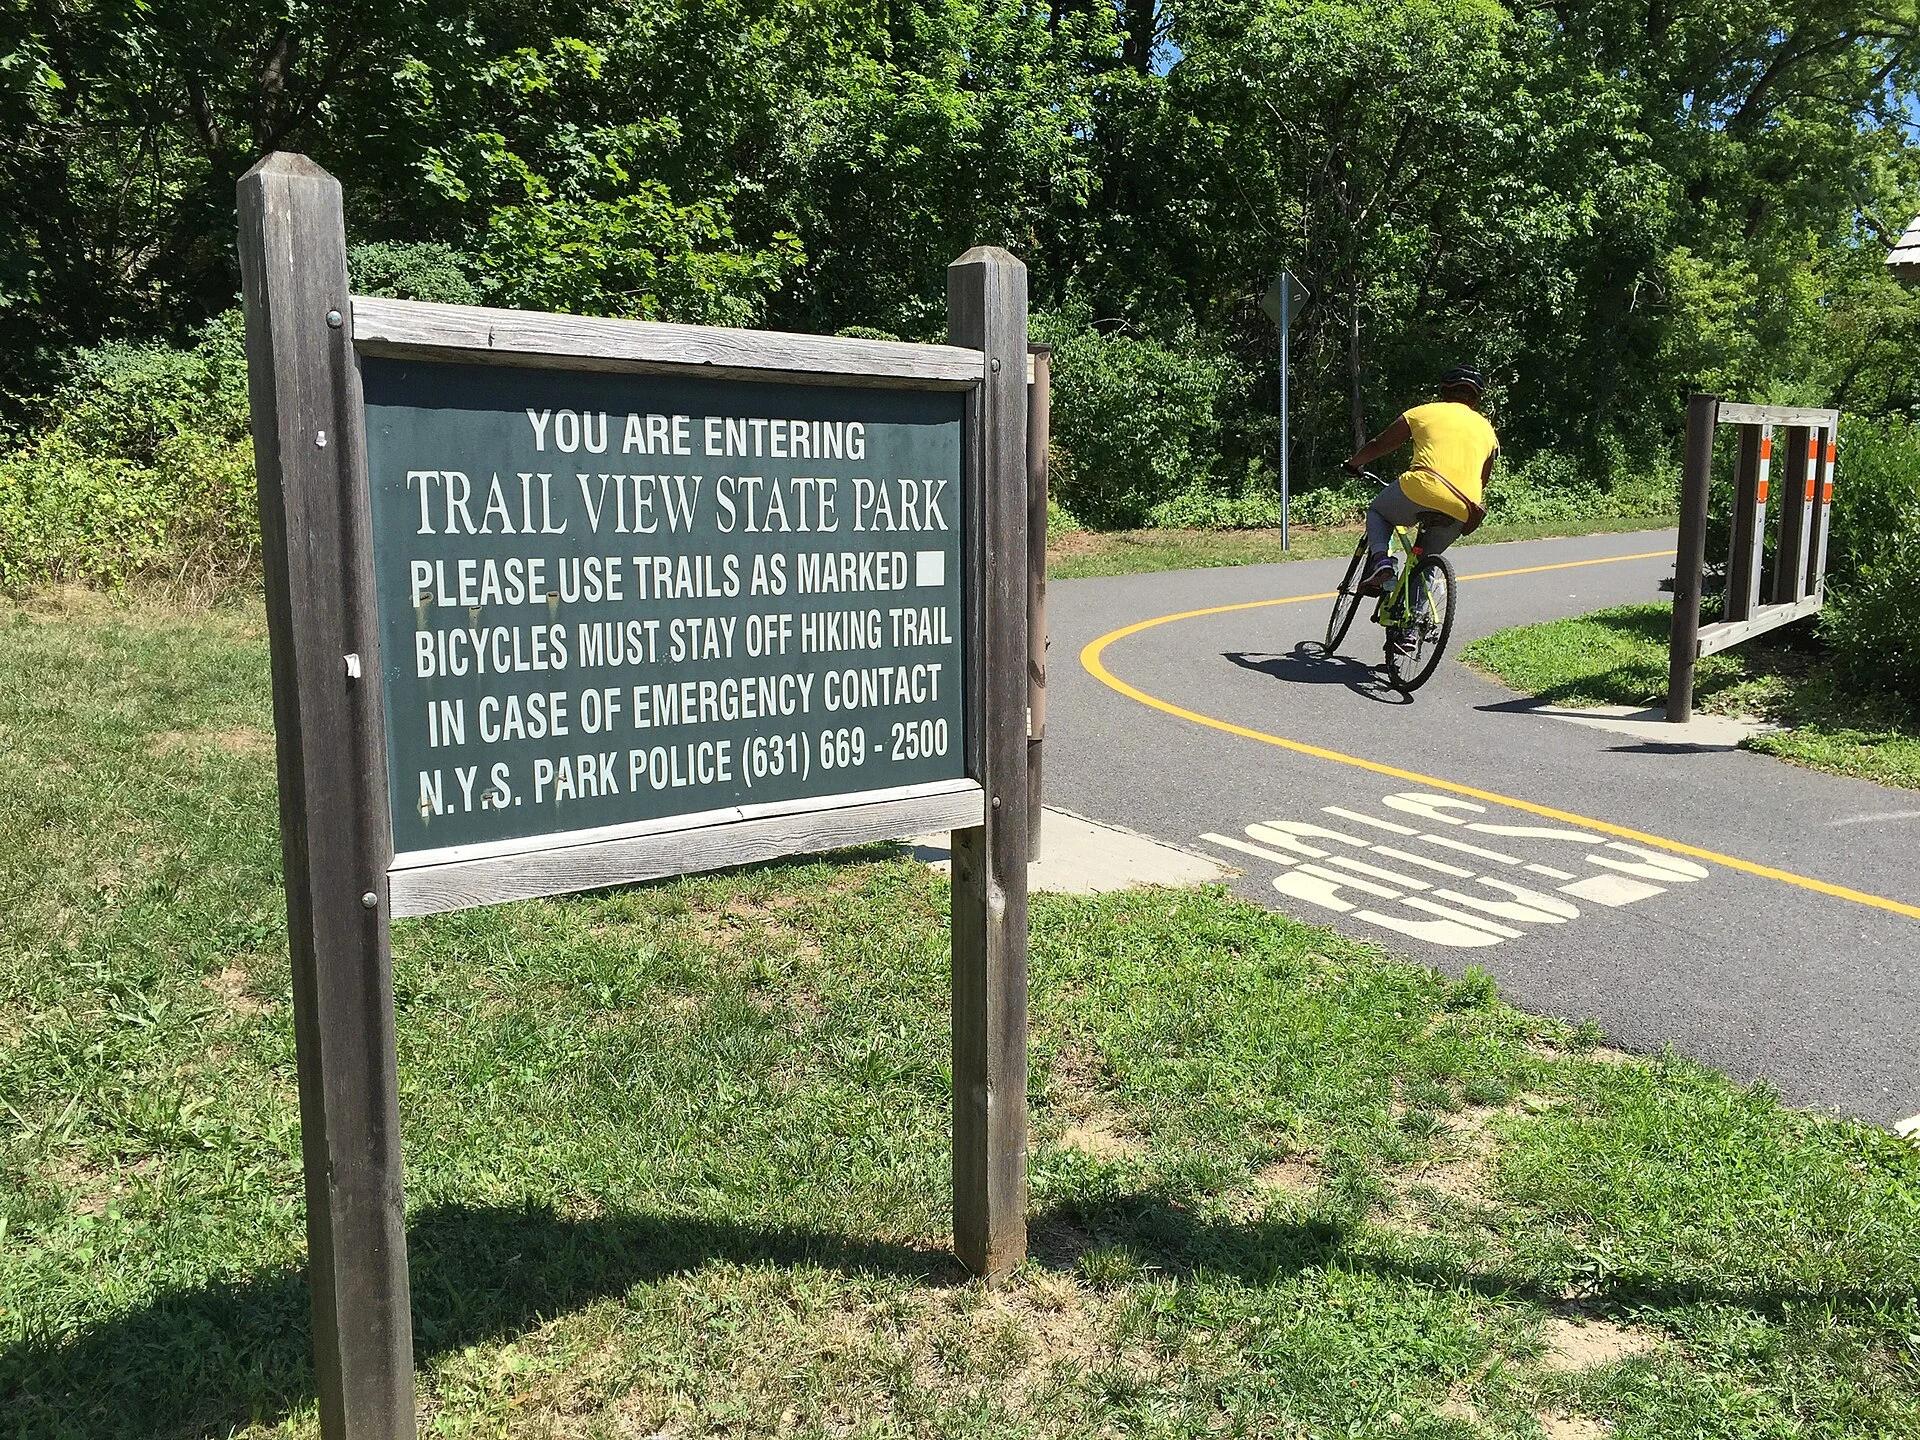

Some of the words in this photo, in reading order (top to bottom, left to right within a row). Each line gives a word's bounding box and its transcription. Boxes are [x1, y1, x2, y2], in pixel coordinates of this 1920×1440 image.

[526, 408, 607, 453] YOU
[622, 413, 691, 457] ARE
[705, 416, 866, 460] ENTERING
[407, 471, 567, 534] TRAIL
[576, 474, 702, 533] VIEW
[717, 476, 838, 532] STATE
[852, 479, 948, 531] PARK
[411, 558, 546, 608] PLEASE
[559, 557, 623, 603] USE
[633, 554, 739, 599] TRAILS
[751, 553, 786, 595] AS
[798, 552, 907, 593] MARKED
[416, 624, 567, 677] BICYCLES
[579, 620, 660, 667] MUST
[670, 617, 736, 662] STAY
[746, 614, 792, 657] OFF
[802, 609, 881, 653] HIKING
[889, 607, 952, 647] TRAIL
[429, 699, 465, 747] IN
[479, 692, 568, 742] CASE
[581, 688, 620, 733] OF
[634, 673, 814, 728] EMERGENCY
[825, 664, 941, 711] CONTACT
[419, 763, 521, 817] N.Y.S.
[534, 752, 618, 803] PARK
[630, 740, 731, 792] POLICE
[743, 732, 809, 787] (631)
[821, 727, 865, 769] 669
[892, 718, 947, 761] 2500
[1198, 792, 1709, 947] STOP
